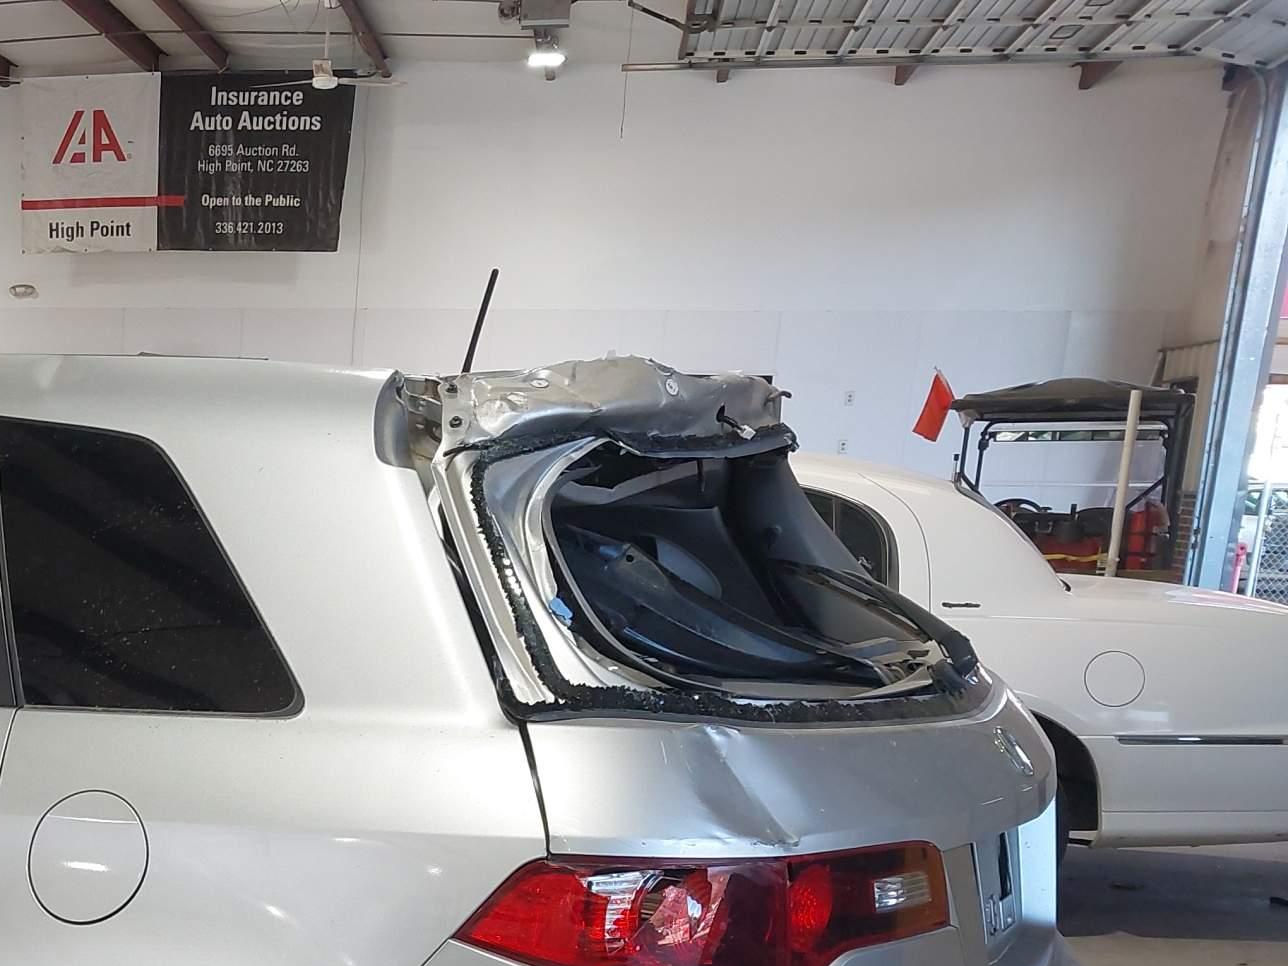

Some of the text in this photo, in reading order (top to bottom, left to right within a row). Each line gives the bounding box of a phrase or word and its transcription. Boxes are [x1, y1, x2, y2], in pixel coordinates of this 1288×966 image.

[211, 86, 304, 106] Insurance
[190, 110, 322, 131] Auto Auctions
[208, 144, 300, 157] 6695 Auction Rd.
[197, 160, 310, 175] High Point, NC 27263
[201, 194, 302, 209] Open to the Public
[48, 220, 132, 242] High Point
[215, 222, 284, 234] 336.421.2013
